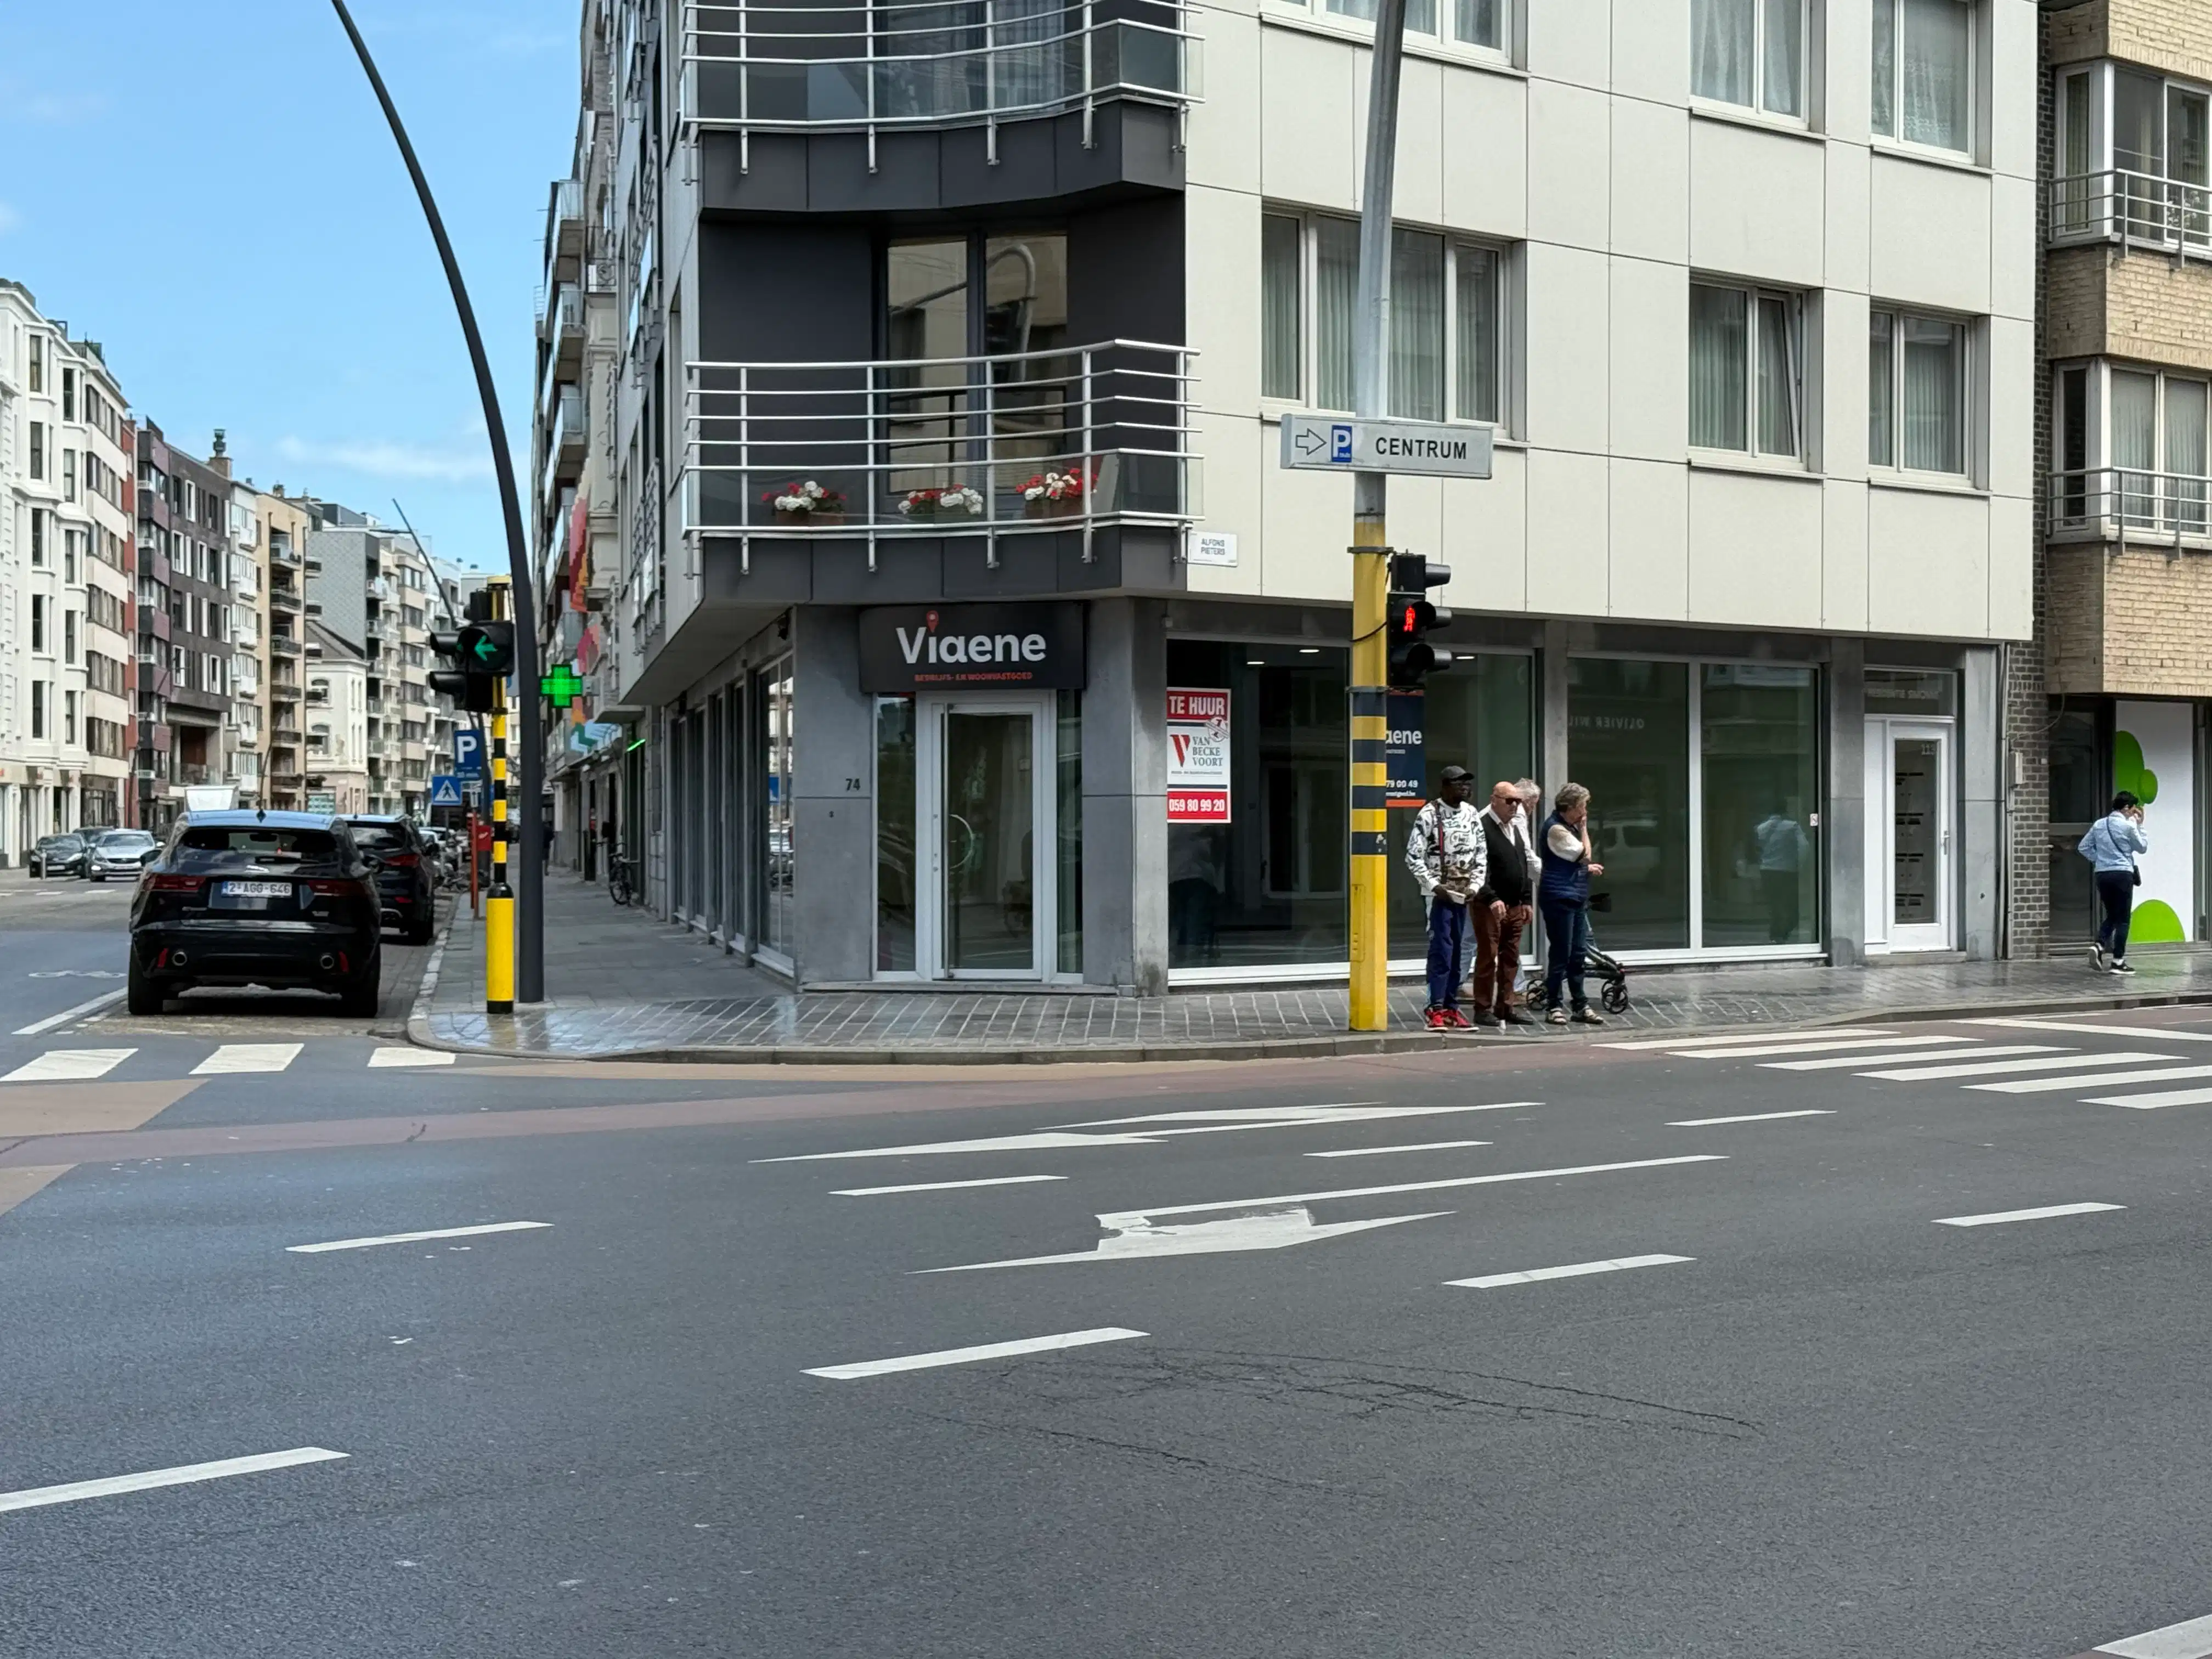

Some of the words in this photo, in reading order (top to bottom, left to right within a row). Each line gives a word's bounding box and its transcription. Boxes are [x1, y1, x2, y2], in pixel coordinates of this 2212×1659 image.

[1333, 429, 1350, 457] P
[1376, 437, 1466, 459] CENTRUM
[895, 627, 1046, 664] Viaene
[1169, 696, 1186, 715] TE
[1188, 696, 1225, 715] HUUR
[1193, 736, 1210, 746] VAN
[1385, 730, 1422, 744] aene
[457, 736, 477, 763] P
[1192, 747, 1221, 756] BECKE
[1192, 757, 1223, 766] VOORT
[845, 778, 861, 791] 74
[1169, 798, 1185, 812] 059
[1187, 798, 1198, 812] 80
[1200, 798, 1211, 812] 99
[1213, 798, 1224, 812] 20
